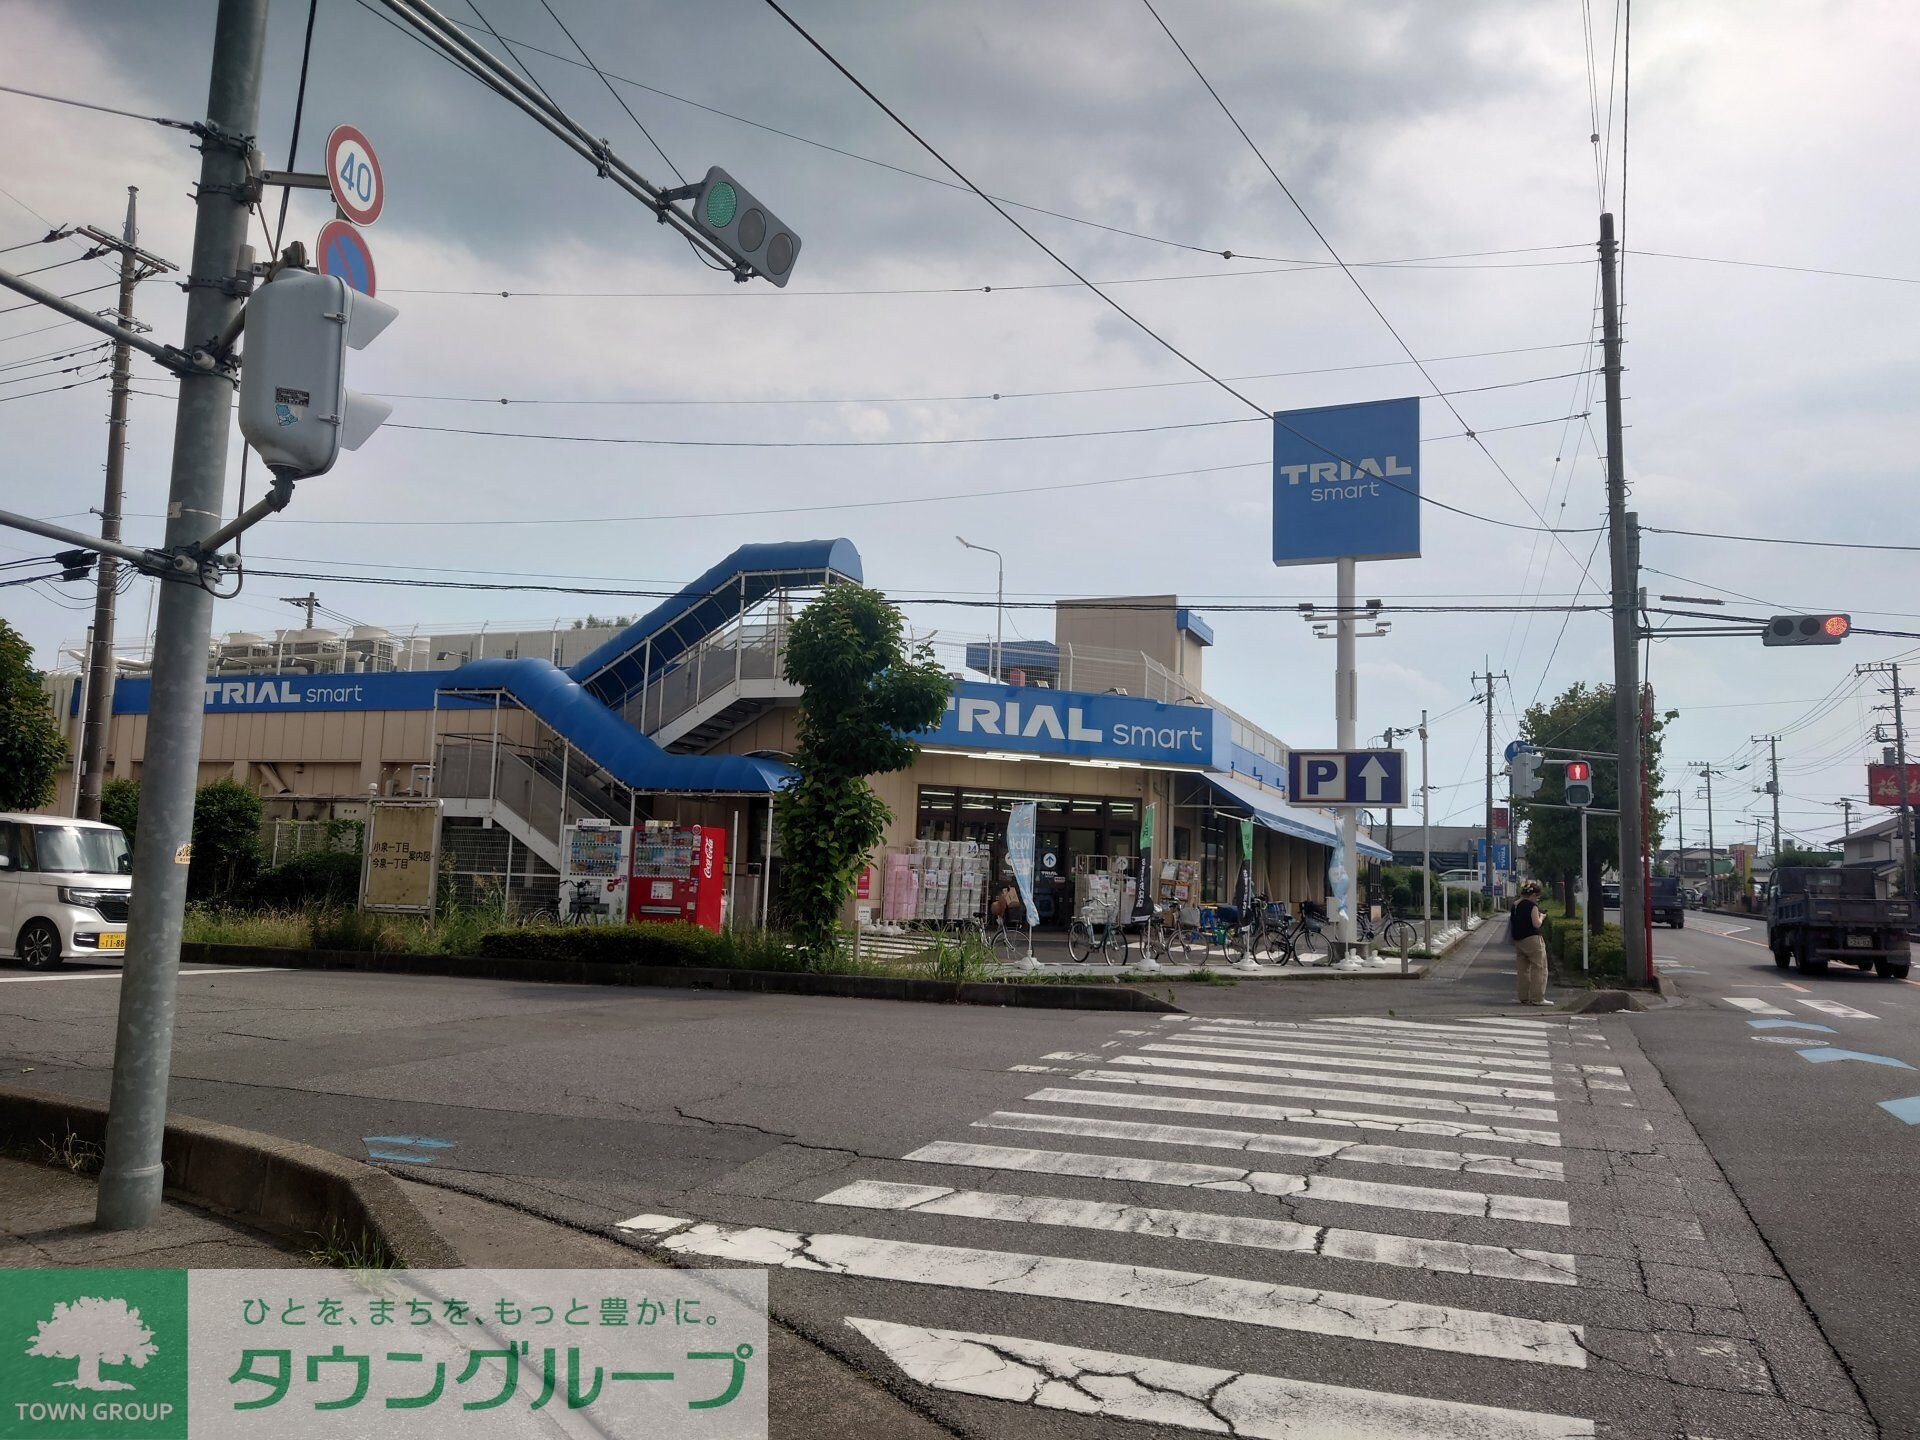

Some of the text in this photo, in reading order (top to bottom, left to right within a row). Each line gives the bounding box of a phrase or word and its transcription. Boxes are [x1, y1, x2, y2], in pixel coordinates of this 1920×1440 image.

[340, 151, 372, 203] 40
[1280, 455, 1412, 485] TRIAL
[1311, 481, 1380, 502] smart
[204, 681, 362, 705] TRIAL smart
[1113, 723, 1203, 751] smart
[1306, 760, 1338, 795] P
[373, 842, 410, 853] 小泉一丁目
